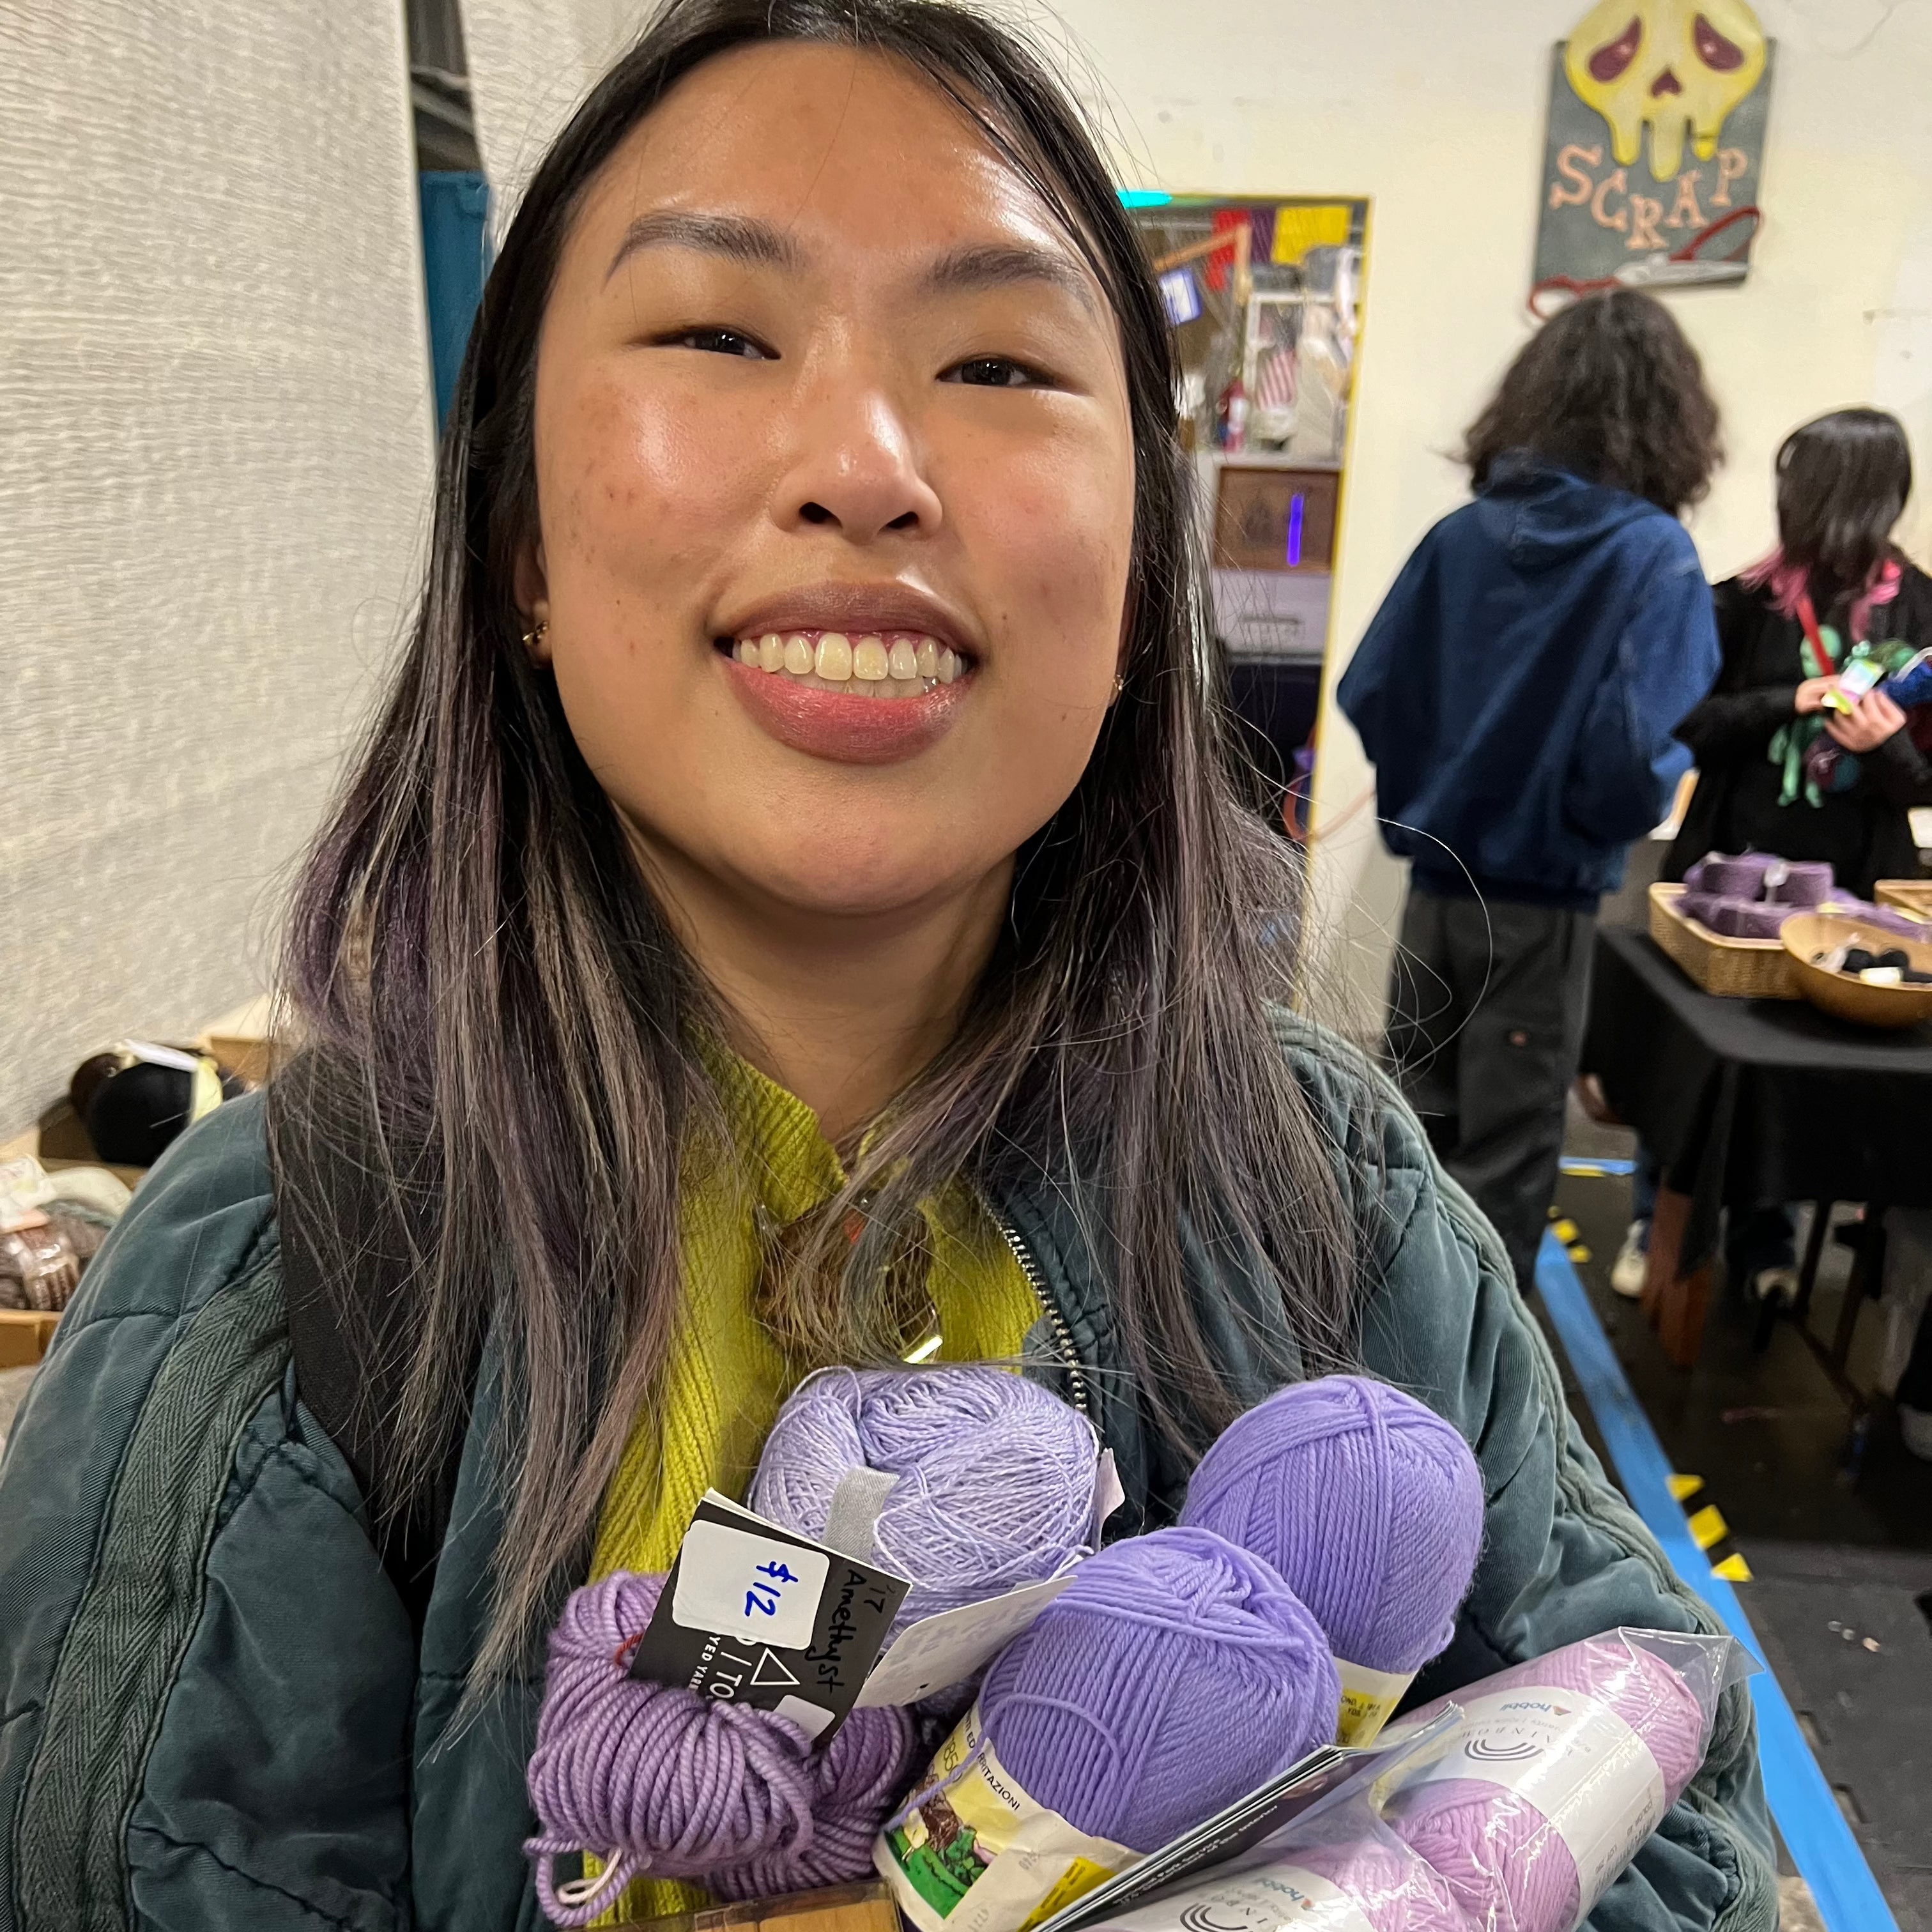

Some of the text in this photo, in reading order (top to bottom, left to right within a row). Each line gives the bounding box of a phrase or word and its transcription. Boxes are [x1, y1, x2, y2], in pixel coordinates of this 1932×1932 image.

[1549, 144, 1749, 249] SCRAP
[744, 1560, 799, 1618] $12
[804, 1568, 868, 1694] Amethyst
[706, 1671, 743, 1700] TO
[977, 1752, 1021, 1811] RRITAZIONI
